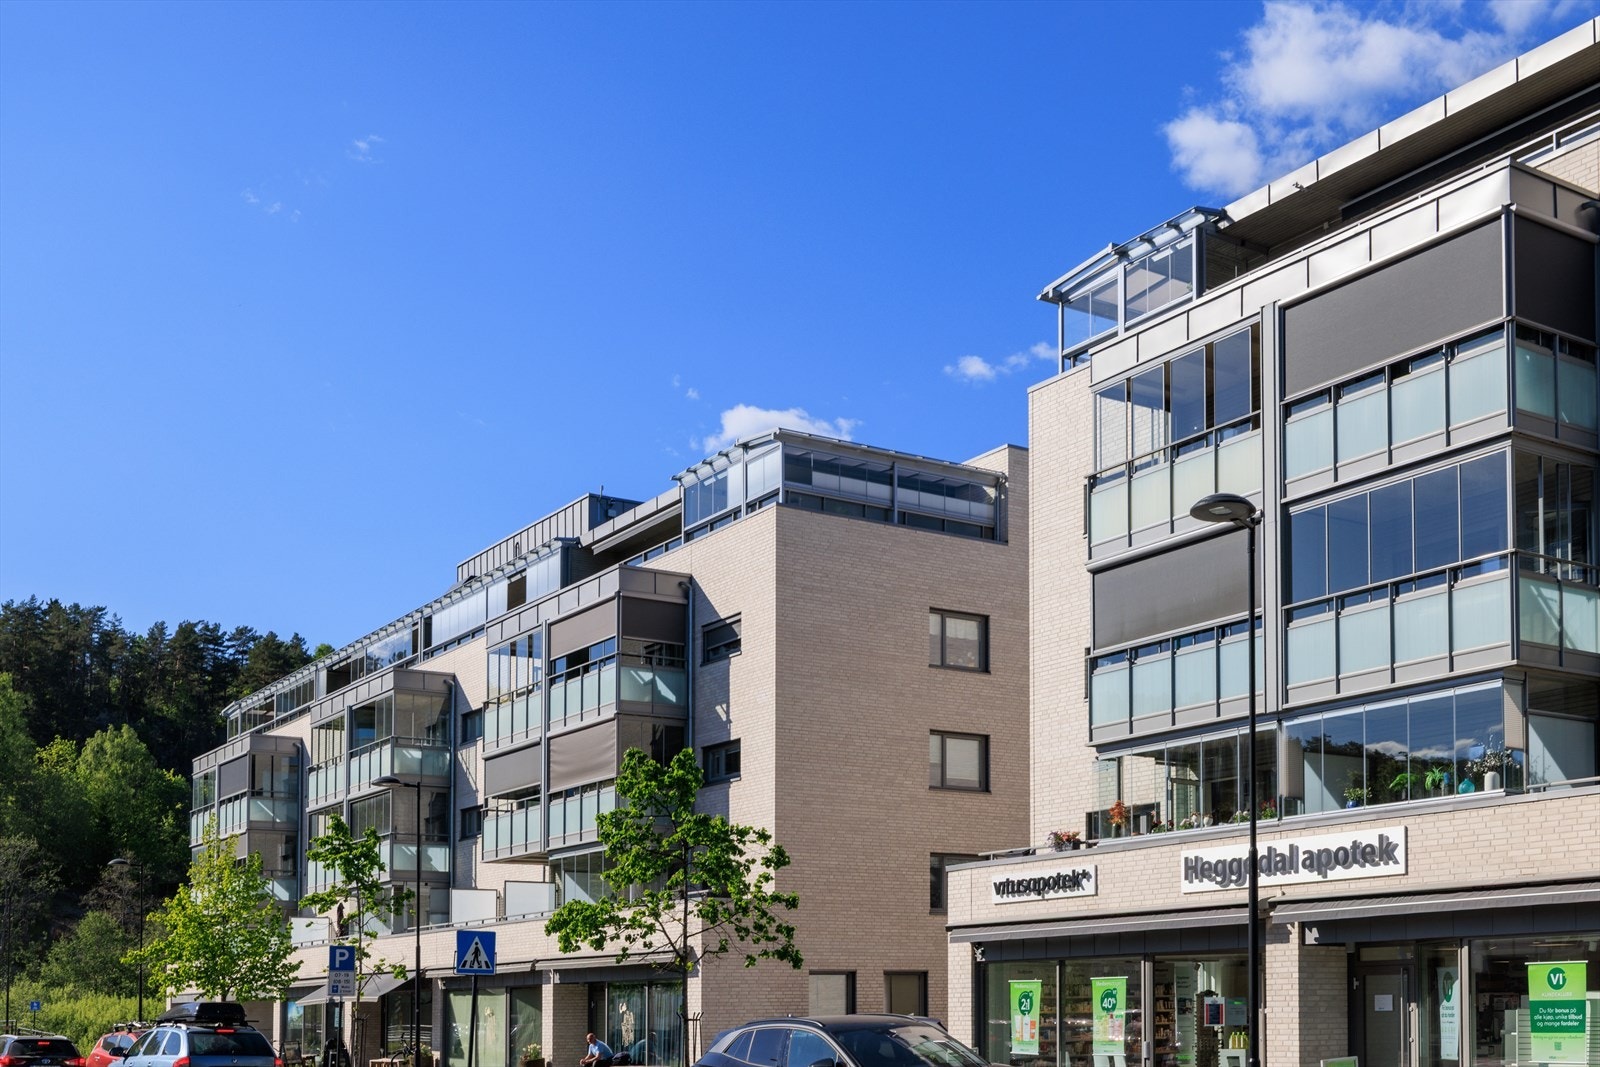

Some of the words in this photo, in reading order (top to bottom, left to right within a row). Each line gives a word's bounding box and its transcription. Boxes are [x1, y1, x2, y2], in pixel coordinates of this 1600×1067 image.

[1184, 844, 1295, 885] Heggdal
[1301, 834, 1396, 876] apotek
[335, 949, 349, 968] P
[1550, 973, 1563, 985] VI
